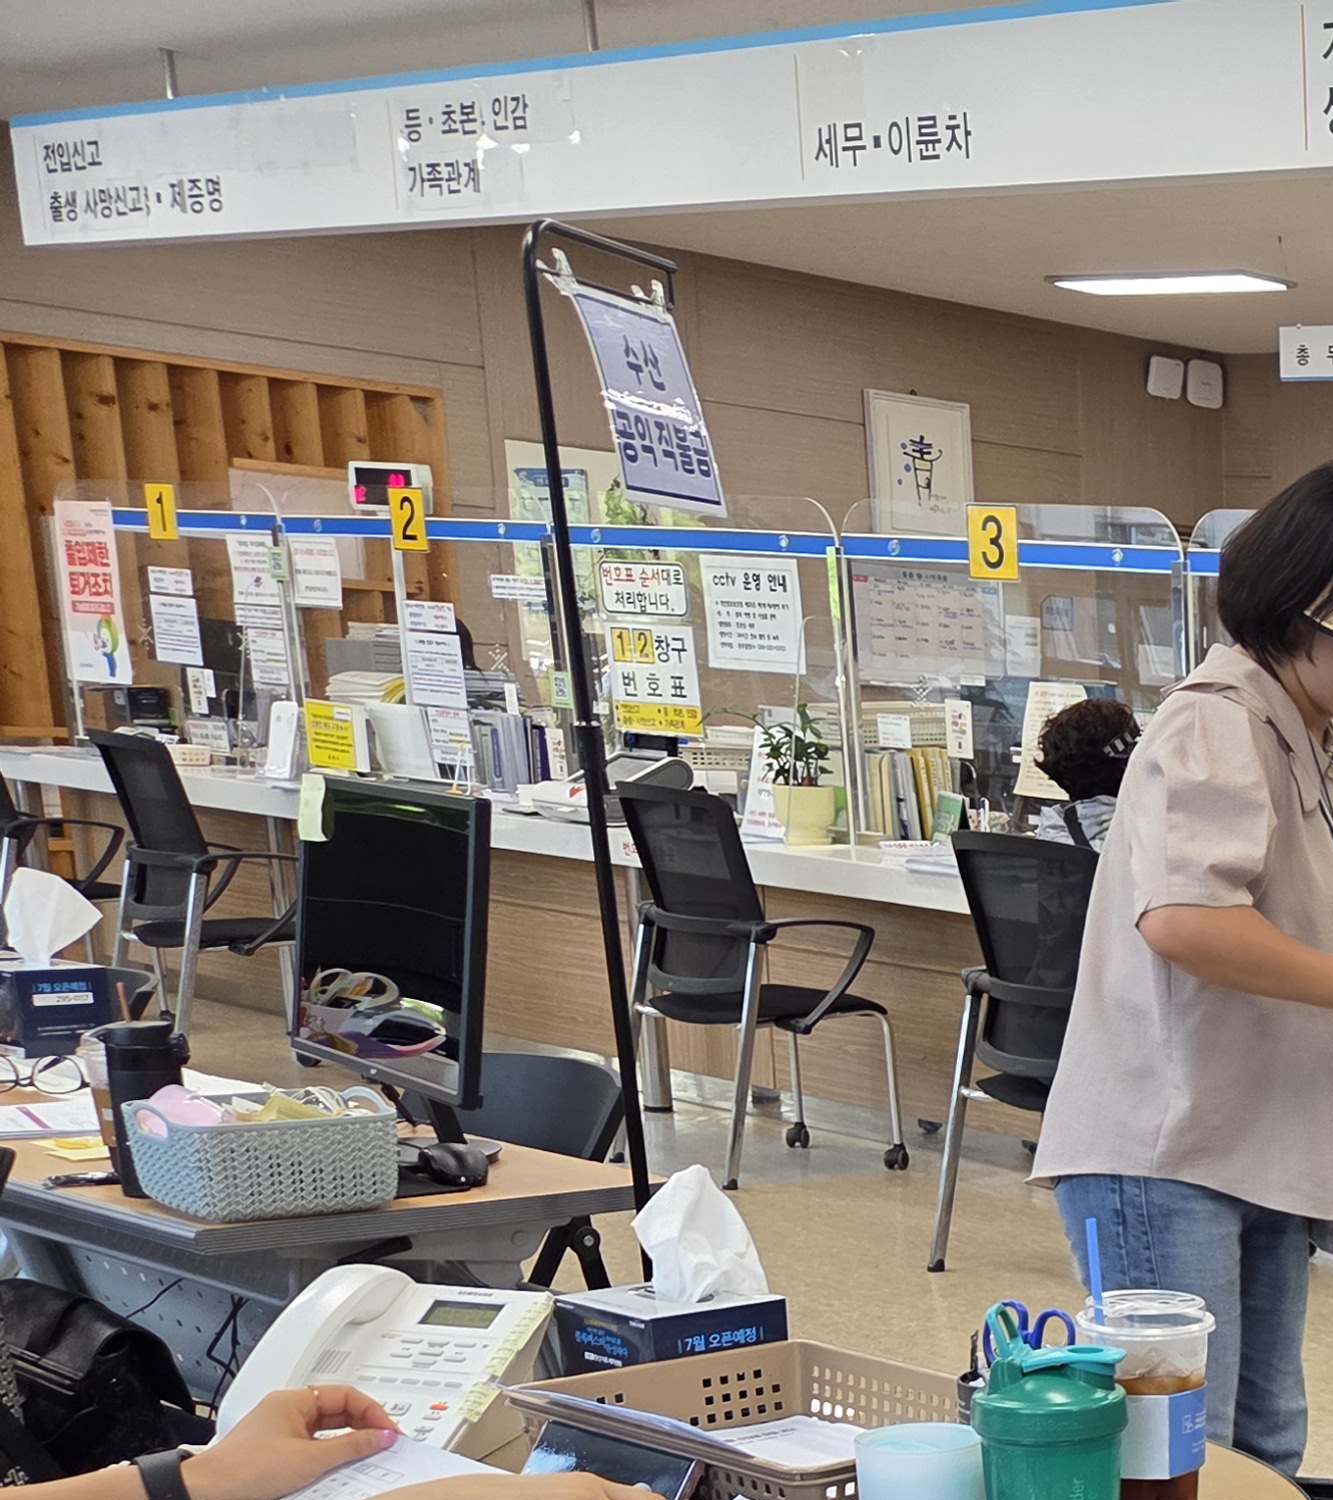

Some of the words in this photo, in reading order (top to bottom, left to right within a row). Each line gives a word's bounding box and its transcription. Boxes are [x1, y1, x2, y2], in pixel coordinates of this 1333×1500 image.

[490, 93, 529, 131] 인감
[43, 139, 103, 174] 전입신고
[407, 158, 482, 198] 가족관계
[155, 490, 168, 534] 1
[399, 496, 418, 540] 2
[981, 515, 1005, 569] 3
[601, 565, 636, 586] 번호표
[638, 567, 684, 588] 순서대로
[712, 571, 737, 587] cctv
[742, 571, 761, 592] 운영
[767, 573, 788, 593] 안내
[684, 1335, 706, 1352] 7월
[708, 1326, 758, 1349] 오픈예정
